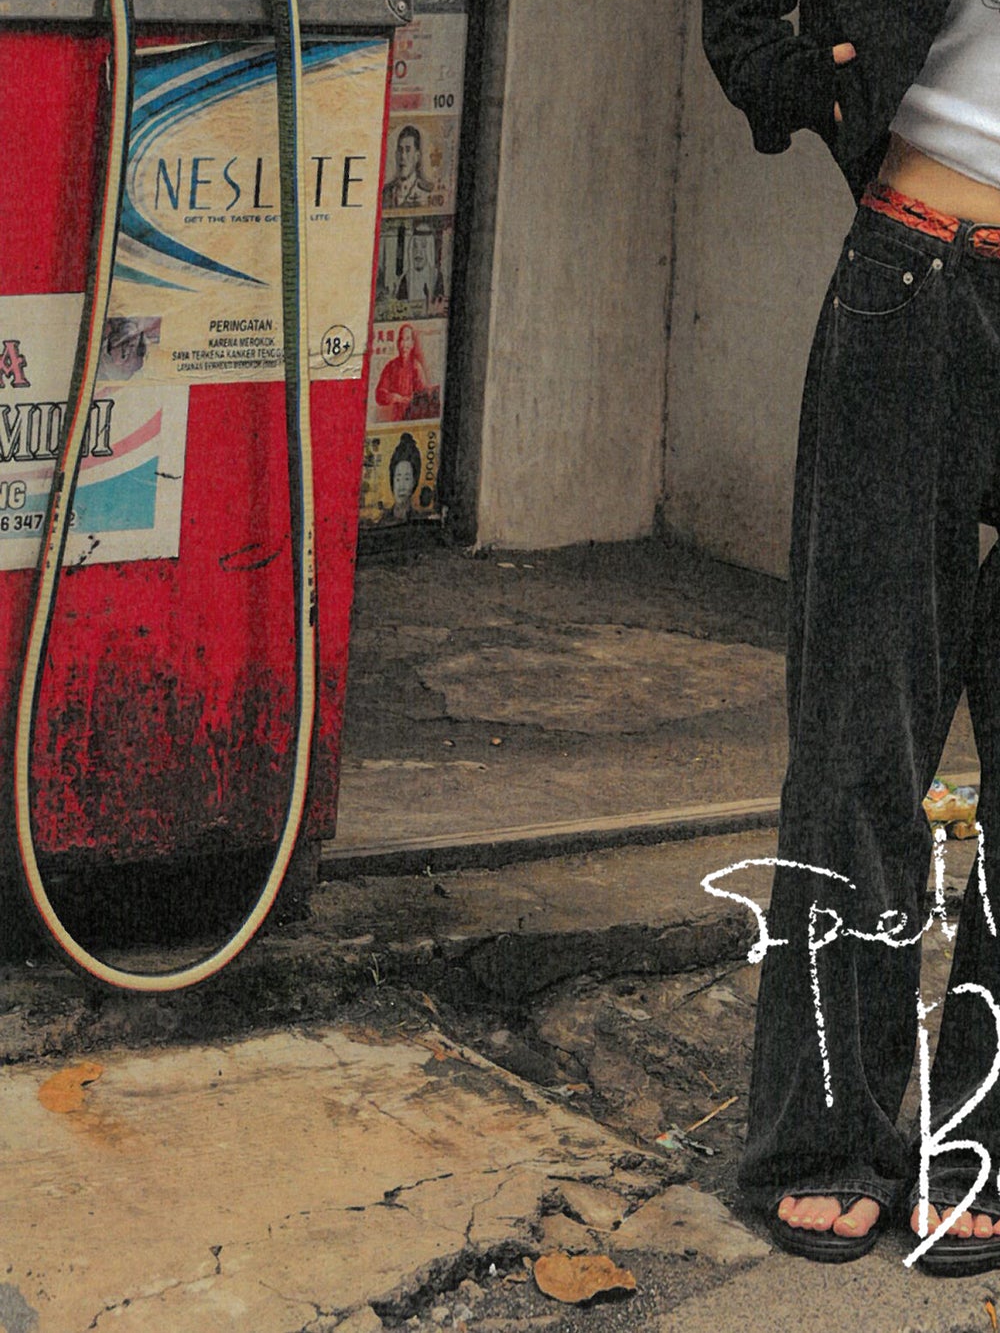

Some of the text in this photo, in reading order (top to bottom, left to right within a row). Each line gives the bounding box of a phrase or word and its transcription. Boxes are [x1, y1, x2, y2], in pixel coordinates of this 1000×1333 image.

[154, 155, 367, 211] NESLTE
[209, 319, 273, 333] PERINGATAN
[325, 337, 351, 356] 18+
